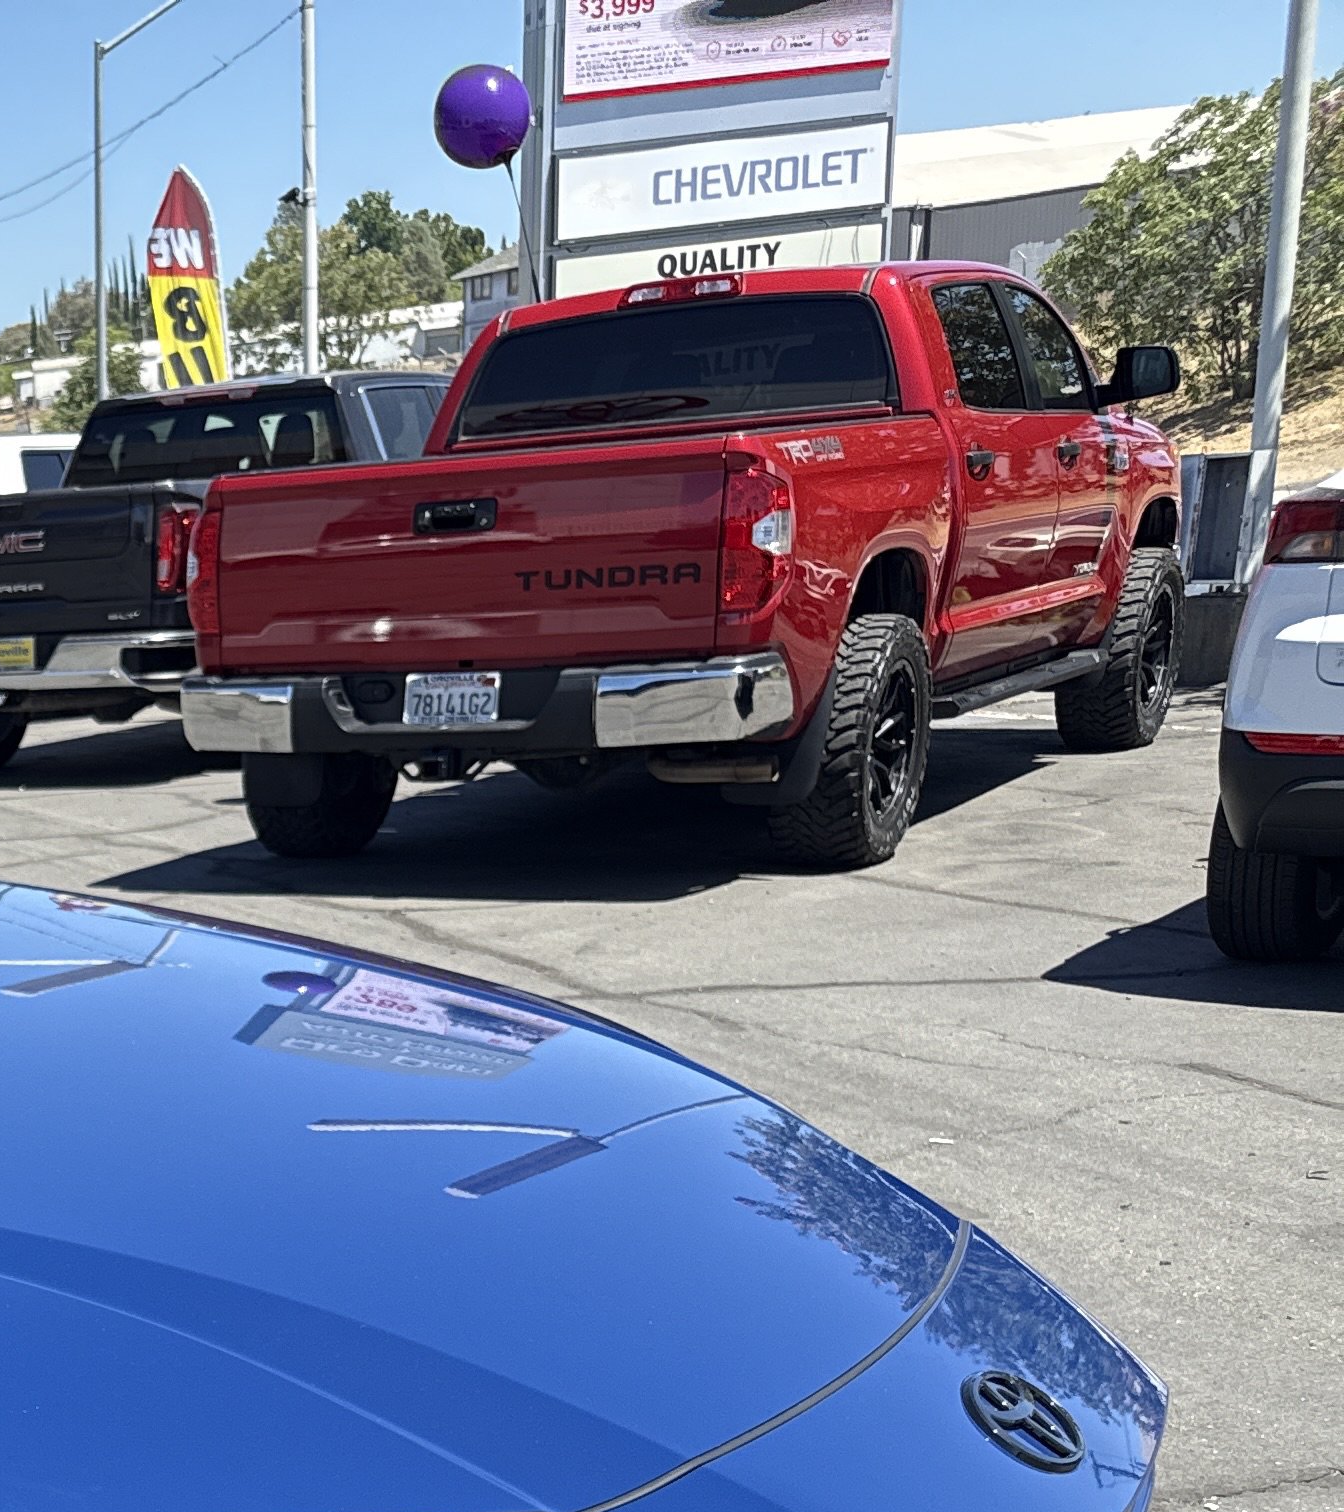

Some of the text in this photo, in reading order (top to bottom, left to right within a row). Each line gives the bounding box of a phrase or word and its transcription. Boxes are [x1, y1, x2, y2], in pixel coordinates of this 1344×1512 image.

[652, 148, 868, 206] CHEVROLET
[657, 241, 782, 279] QUALITY
[514, 562, 702, 592] TUNDRA
